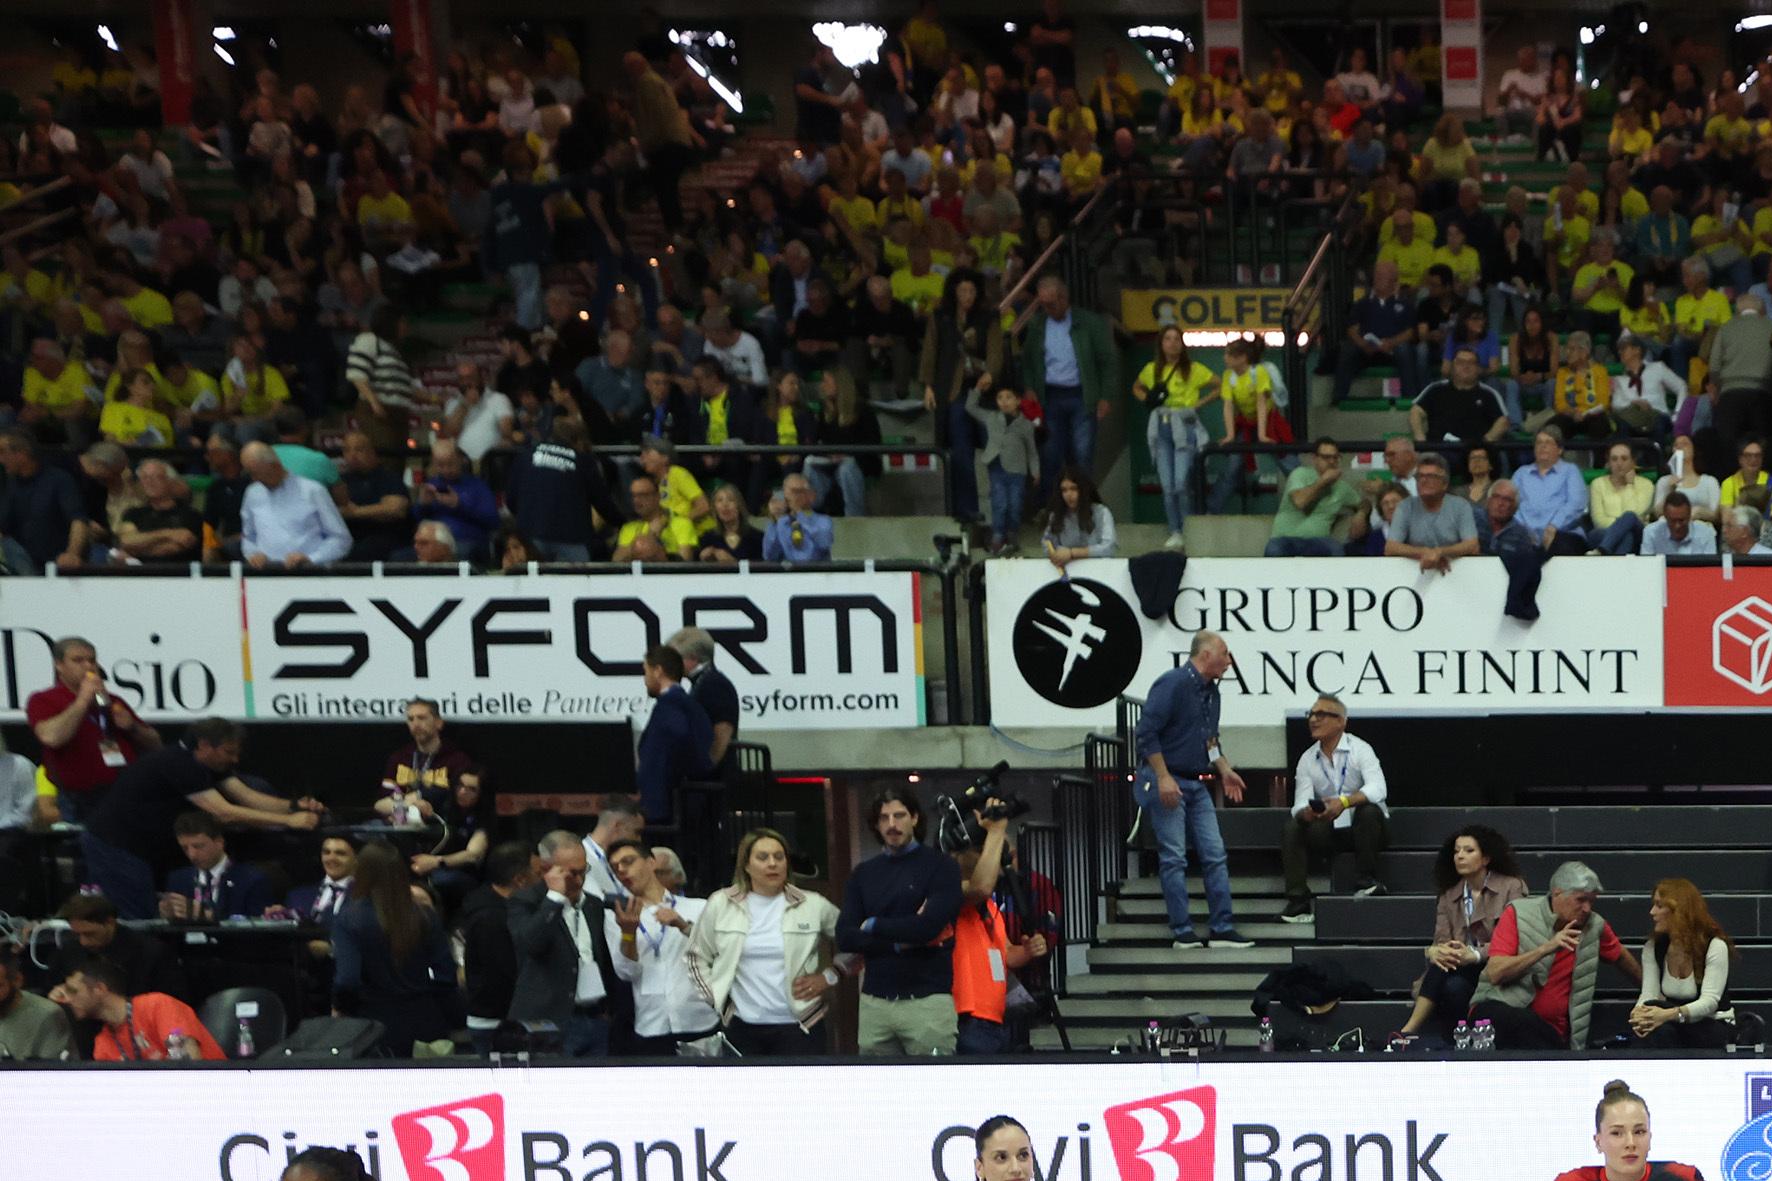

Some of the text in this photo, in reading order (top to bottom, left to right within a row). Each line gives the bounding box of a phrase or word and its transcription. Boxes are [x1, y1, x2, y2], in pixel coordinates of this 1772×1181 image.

[1152, 294, 1306, 326] COLFE
[1167, 586, 1425, 633] GRUPPO
[271, 597, 899, 679] SYFORM
[0, 628, 216, 711] Dsio
[1414, 650, 1638, 695] FININT
[272, 693, 308, 715] Gli
[477, 691, 533, 714] delle
